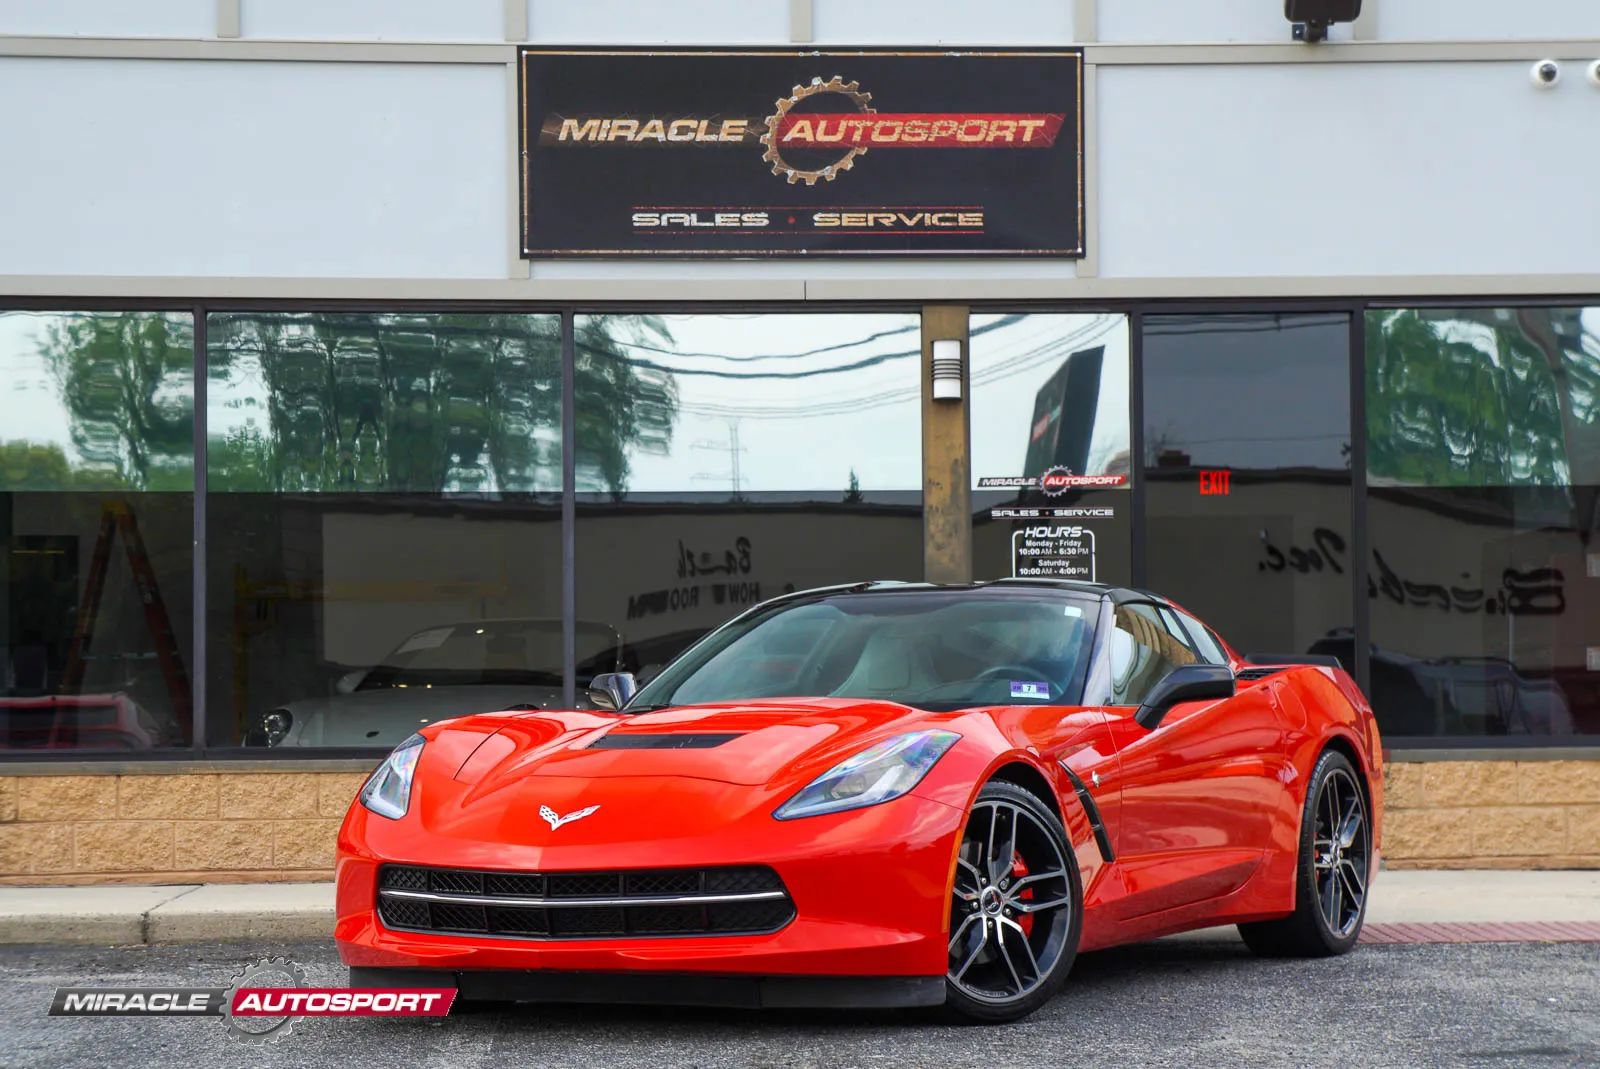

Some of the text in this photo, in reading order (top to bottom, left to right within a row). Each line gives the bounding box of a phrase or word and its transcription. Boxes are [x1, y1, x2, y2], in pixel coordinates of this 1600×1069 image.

[558, 118, 1046, 143] MIRACLE AUTOSPORT
[631, 211, 984, 228] SALES SERVICE
[982, 476, 1121, 486] MIRACLE AUTOSPORT
[1200, 469, 1230, 496] EXIT
[991, 508, 1114, 517] SALES SERVICE
[1024, 526, 1083, 538] HOURS
[1025, 540, 1053, 548] Monday
[1059, 540, 1082, 548] Friday
[1038, 559, 1070, 567] Saturday
